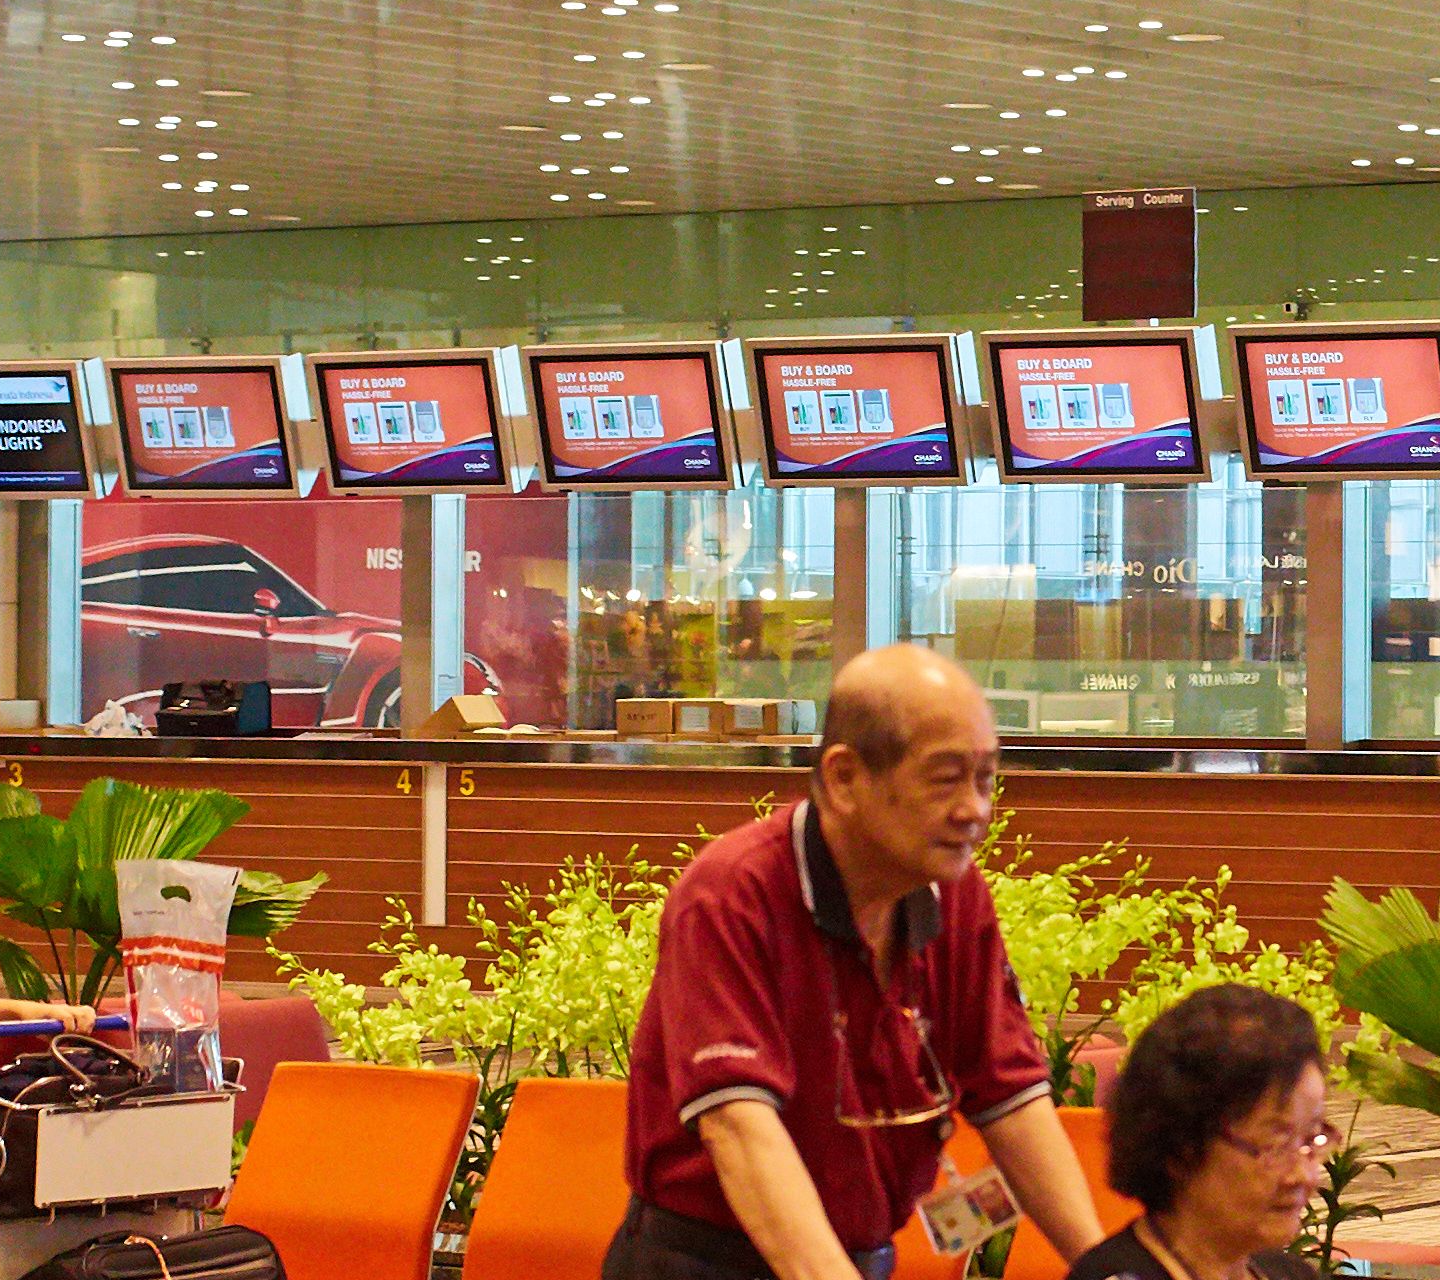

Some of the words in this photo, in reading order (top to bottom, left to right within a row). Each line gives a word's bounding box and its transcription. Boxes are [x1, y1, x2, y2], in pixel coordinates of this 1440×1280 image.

[1095, 195, 1135, 208] Serving
[1143, 193, 1184, 205] Counter
[1017, 360, 1040, 370] BUY
[1043, 359, 1050, 369] &
[1053, 358, 1092, 369] BOARD
[1265, 354, 1288, 364] BUY
[1292, 354, 1299, 363] &
[1303, 352, 1344, 363] BOARD
[781, 366, 802, 376] BUY
[806, 366, 813, 375] &
[816, 365, 852, 375] BOARD
[1266, 367, 1325, 375] HASSLE-FREE
[556, 373, 576, 383] BUY
[579, 373, 586, 382] &
[589, 371, 624, 381] BOARD
[340, 379, 360, 389] BUY
[363, 379, 369, 388] &
[372, 378, 406, 388] BOARD
[9, 762, 24, 787] 3
[396, 769, 412, 795] 4
[460, 770, 475, 795] 5
